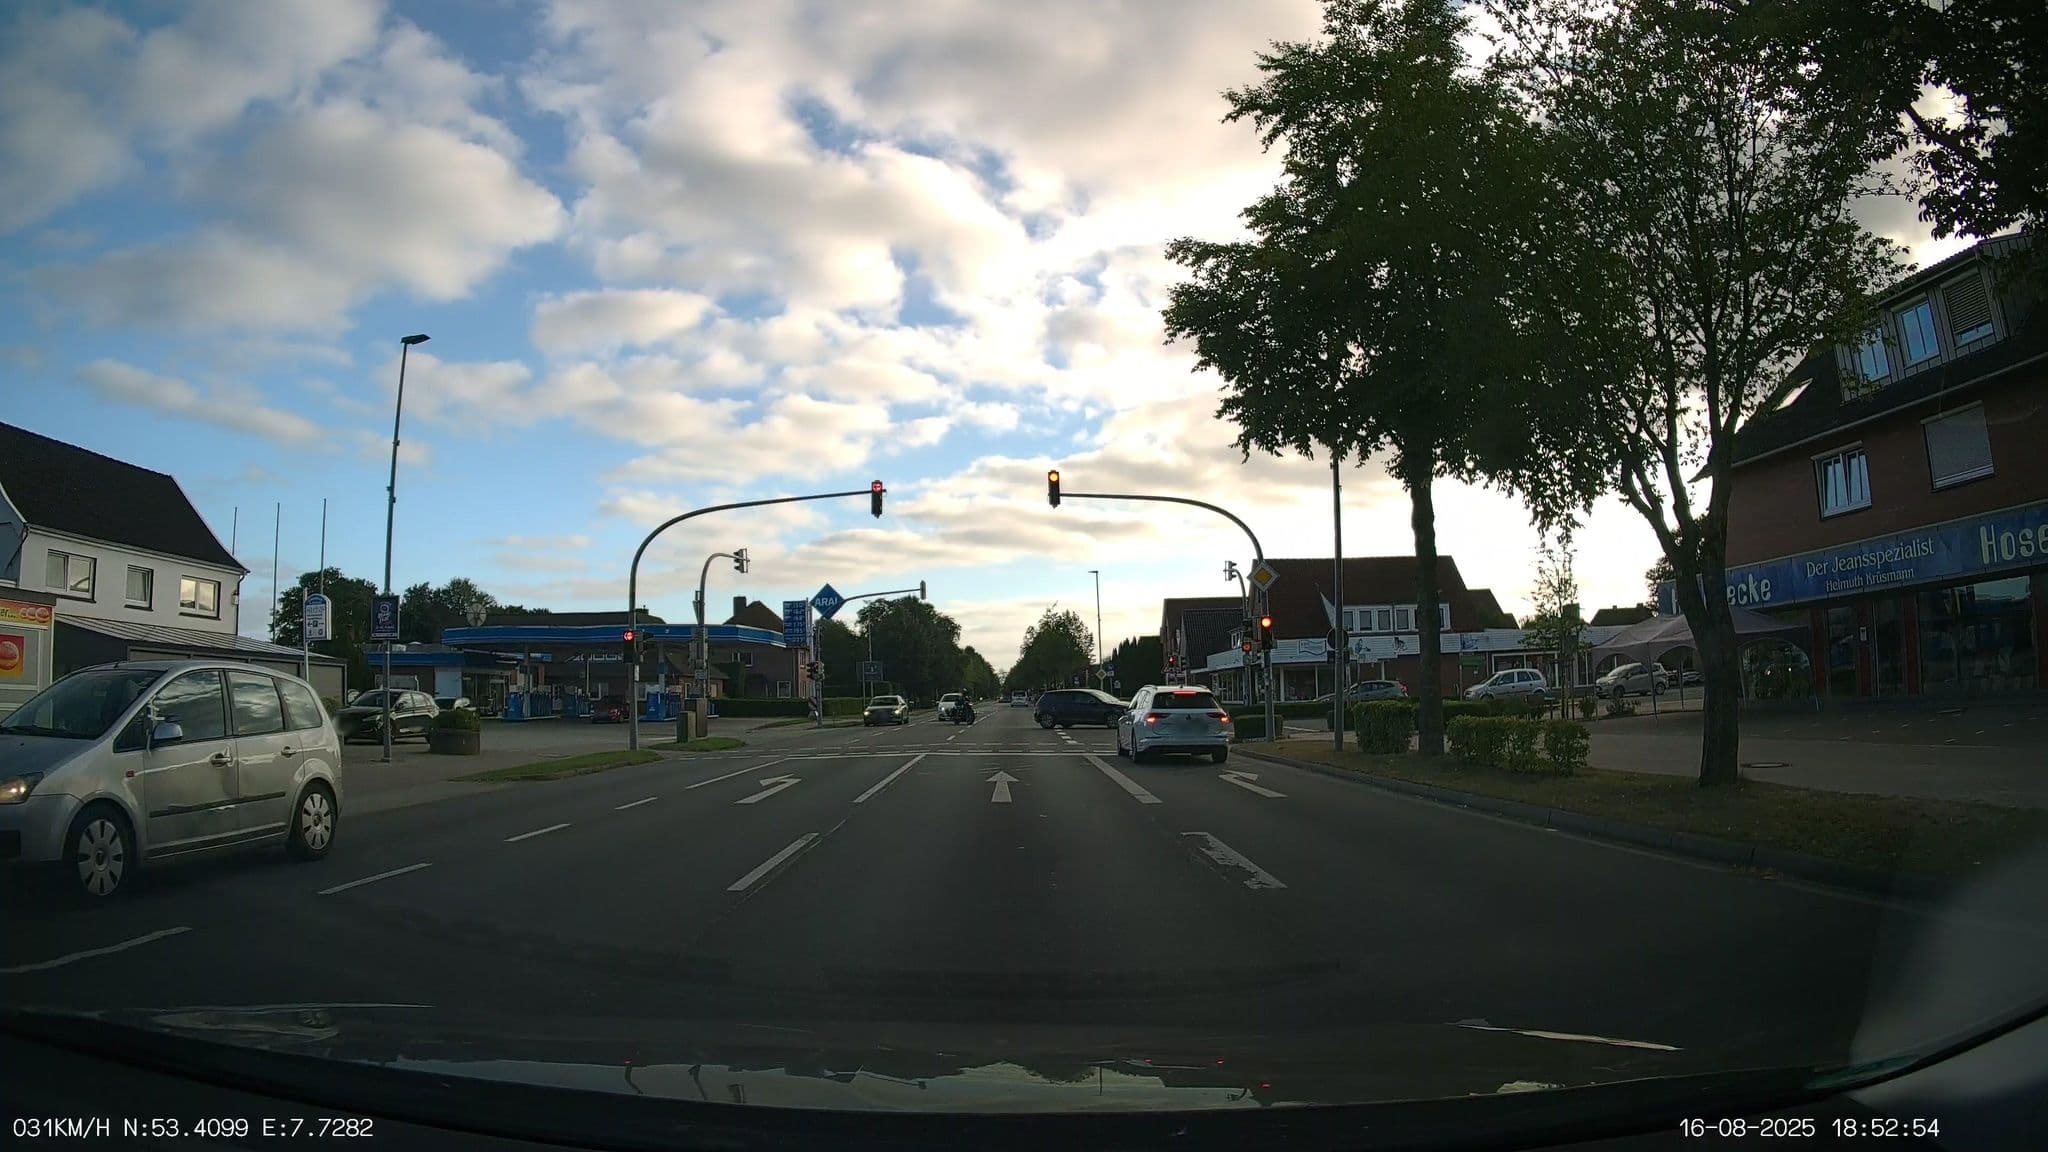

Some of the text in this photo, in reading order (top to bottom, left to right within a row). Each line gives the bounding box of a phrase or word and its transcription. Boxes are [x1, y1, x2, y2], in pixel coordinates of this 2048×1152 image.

[1806, 537, 1935, 578] Der Jeansspezialist
[1979, 524, 2048, 565] Hose
[1726, 573, 1771, 606] ecke
[1826, 575, 1864, 593] Helmuth
